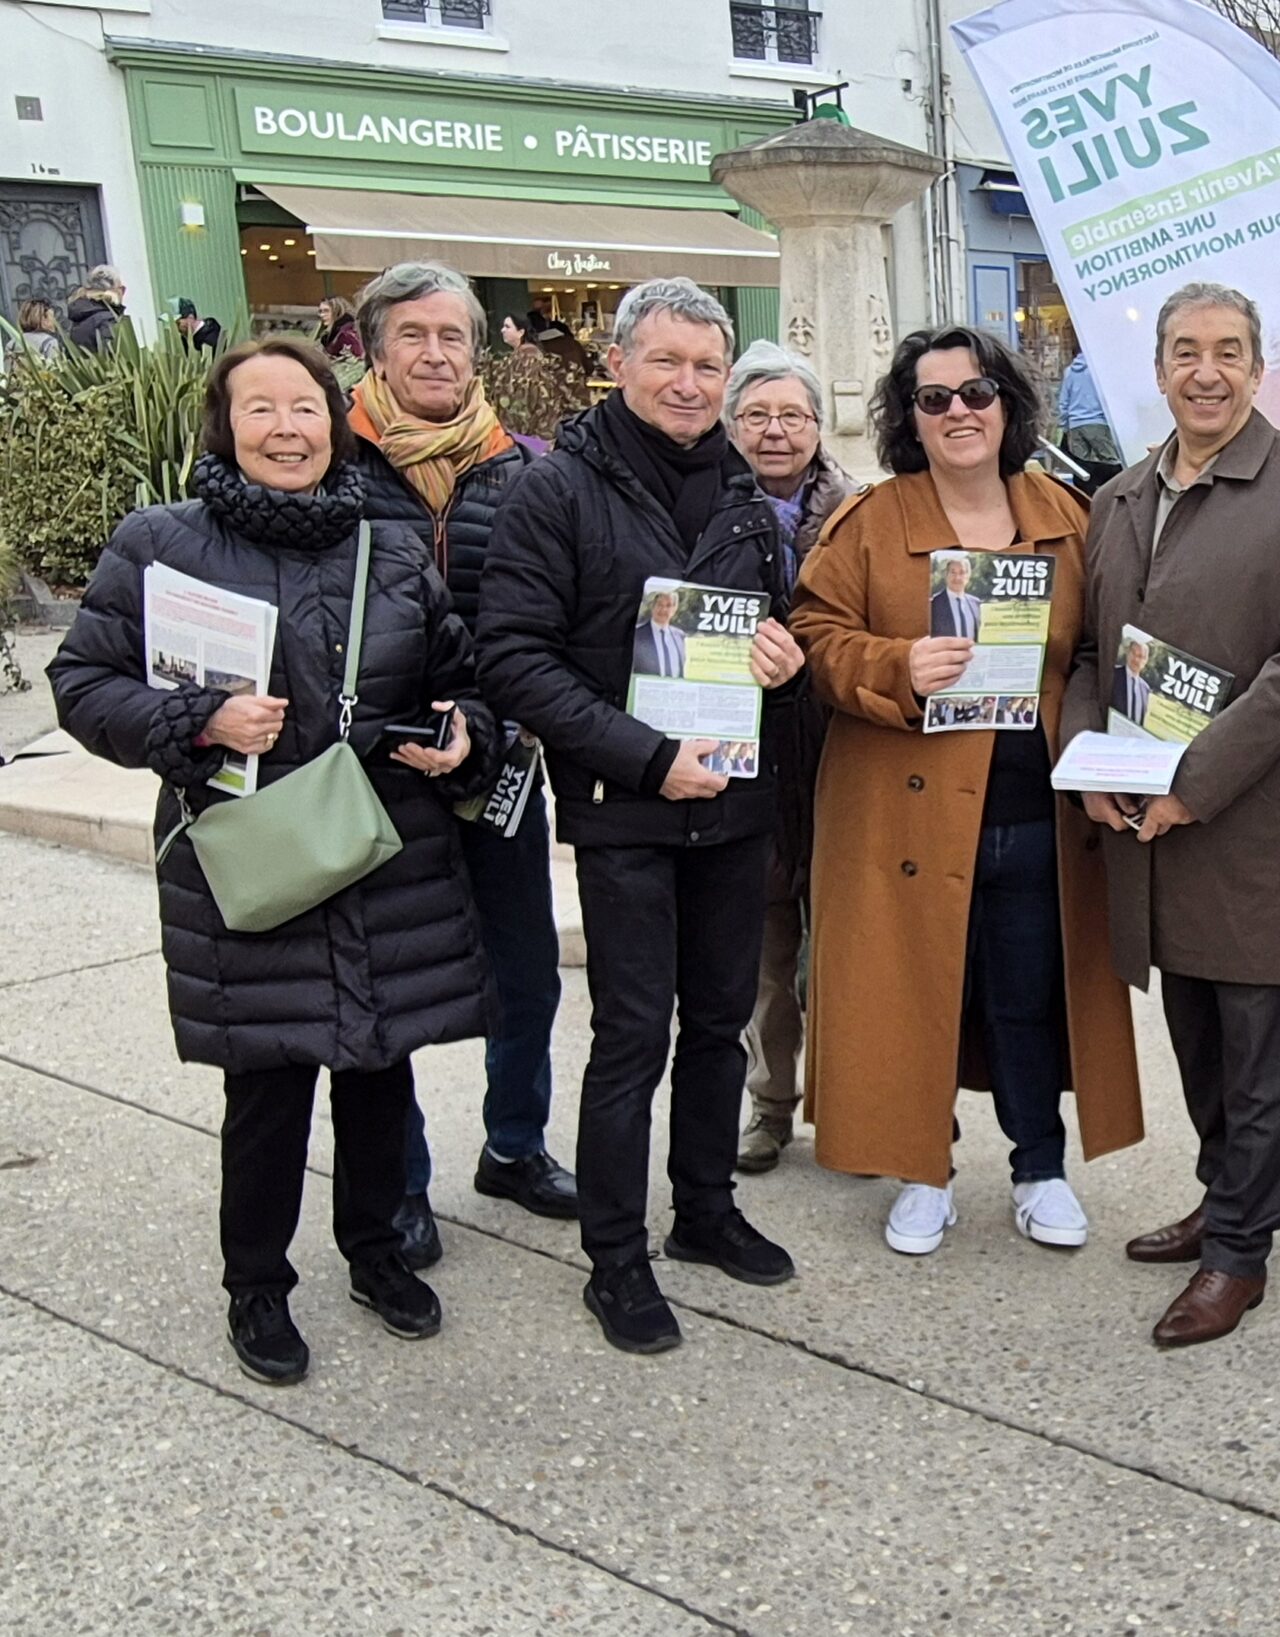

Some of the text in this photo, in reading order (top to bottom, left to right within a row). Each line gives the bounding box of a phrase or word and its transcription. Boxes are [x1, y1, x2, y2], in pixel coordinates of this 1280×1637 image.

[254, 106, 712, 166] BOULANGERIE PÂTISSERIE
[547, 251, 612, 276] Chez Justine
[992, 560, 1048, 578] YVES
[991, 578, 1045, 596] ZUILI
[702, 594, 760, 616] YVES
[697, 613, 757, 635] ZUILI
[1167, 656, 1221, 695] YVES
[1160, 674, 1215, 712] ZUILI
[483, 763, 516, 821] ZUILI
[494, 769, 526, 827] YVES
